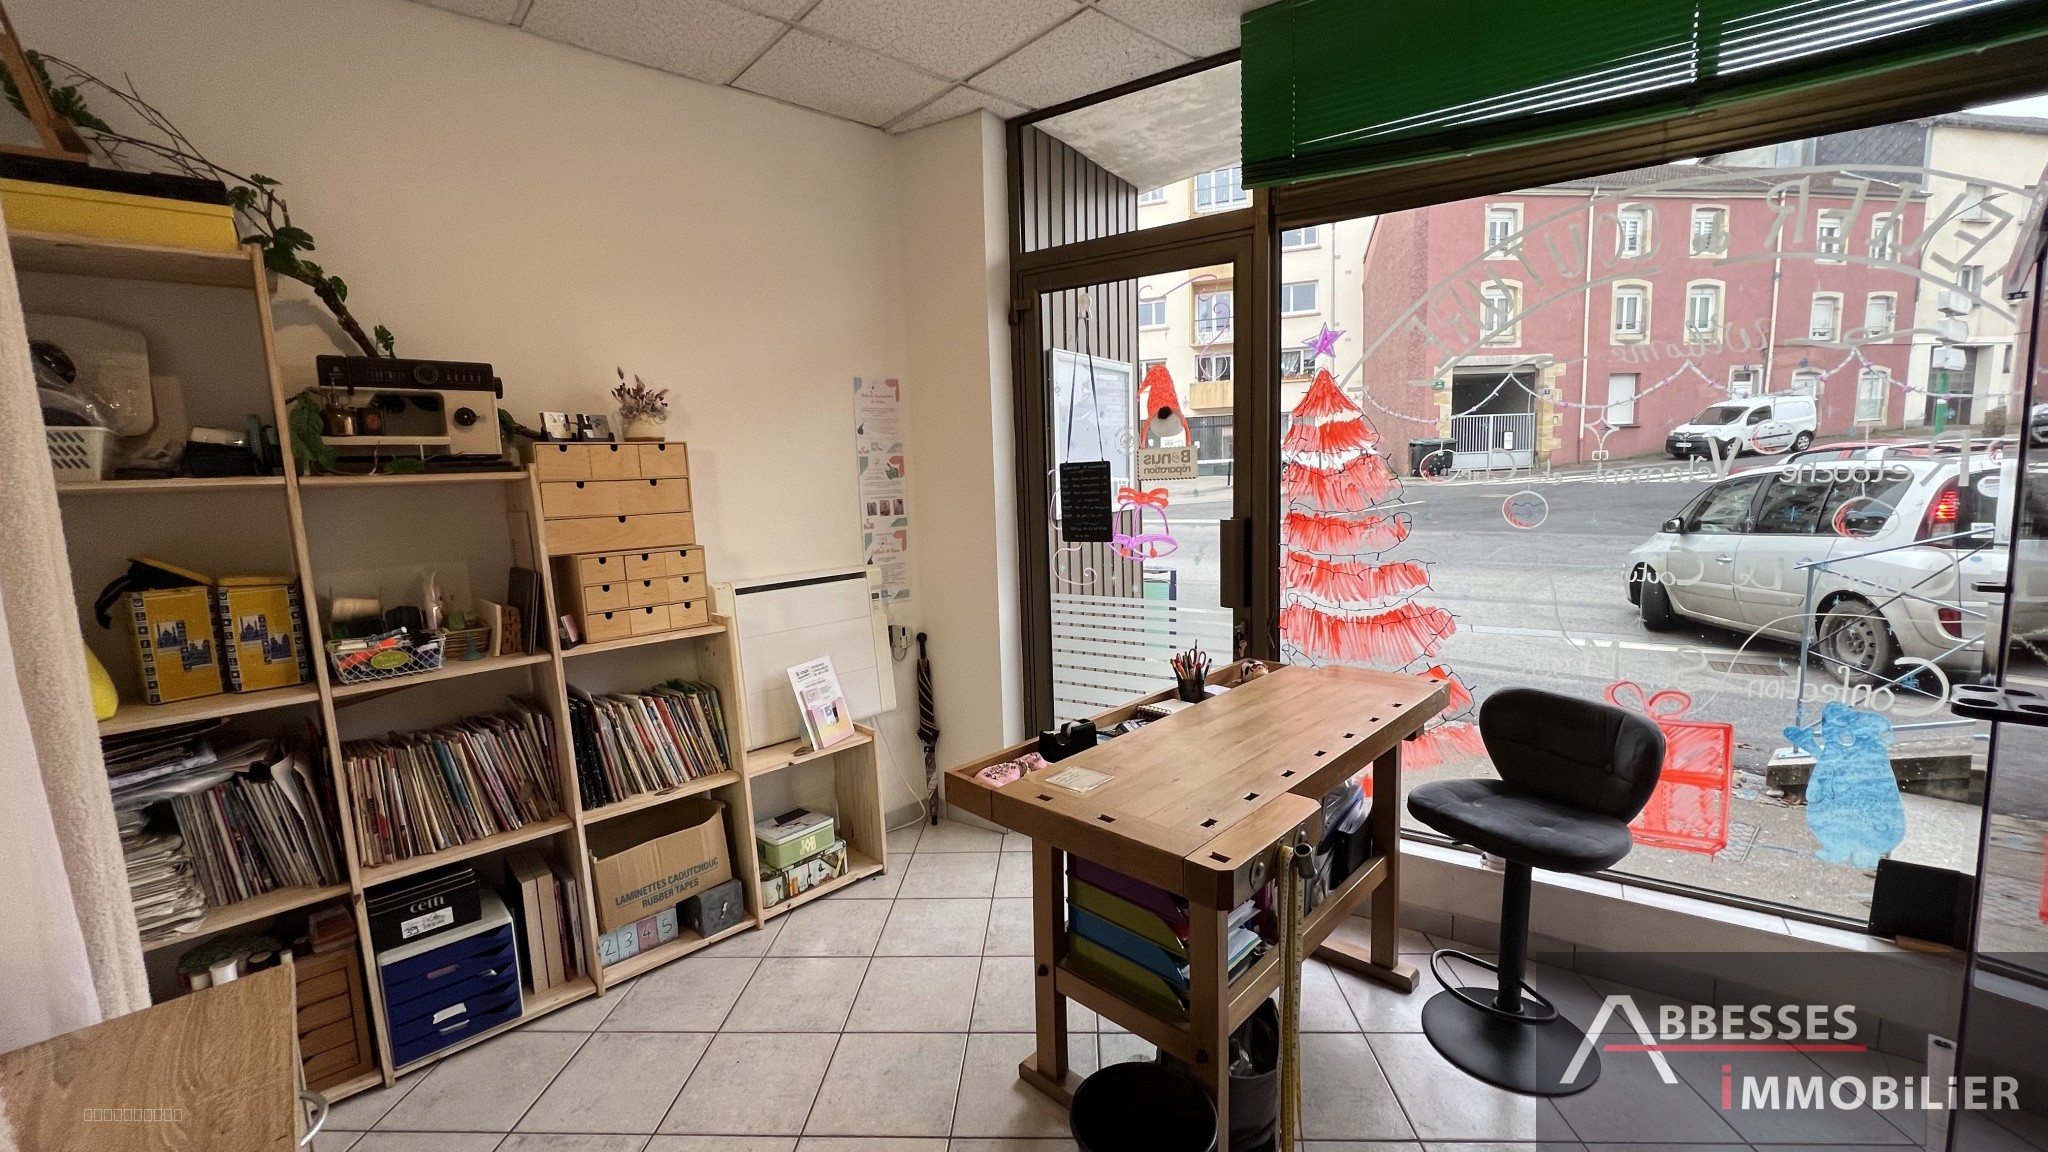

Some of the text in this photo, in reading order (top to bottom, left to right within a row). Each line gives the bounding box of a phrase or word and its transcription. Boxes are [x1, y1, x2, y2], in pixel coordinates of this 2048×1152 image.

[615, 857, 719, 906] LAMINETTES CAOUTCHOUC
[641, 878, 700, 909] RUBBER TAPES
[601, 918, 673, 957] 2 3 4 5
